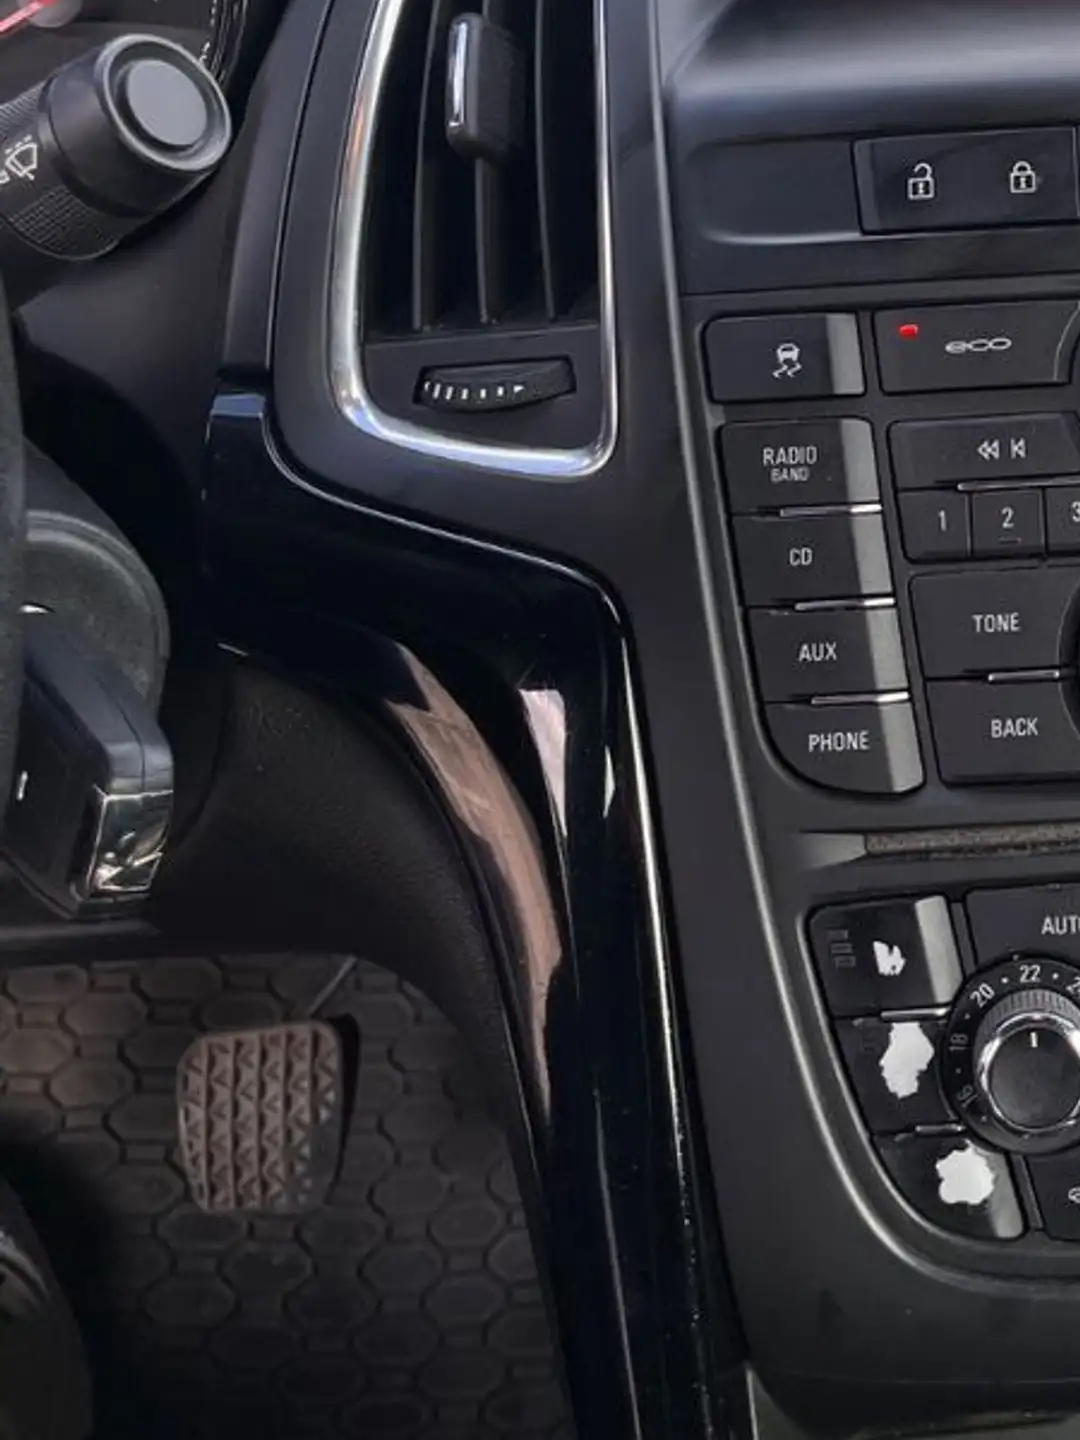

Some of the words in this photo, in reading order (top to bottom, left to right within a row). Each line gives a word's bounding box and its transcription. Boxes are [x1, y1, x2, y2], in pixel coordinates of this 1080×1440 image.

[763, 446, 818, 467] RADIO
[771, 467, 809, 482] BAND
[938, 510, 947, 530] 1
[1002, 508, 1014, 529] 2
[789, 547, 812, 566] CD
[972, 612, 1020, 633] TONE
[799, 643, 837, 662] AUX
[991, 718, 1038, 738] BACK
[808, 731, 870, 753] PHONE
[1019, 964, 1042, 983] 22
[969, 983, 995, 1008] 20
[949, 1033, 969, 1051] 18
